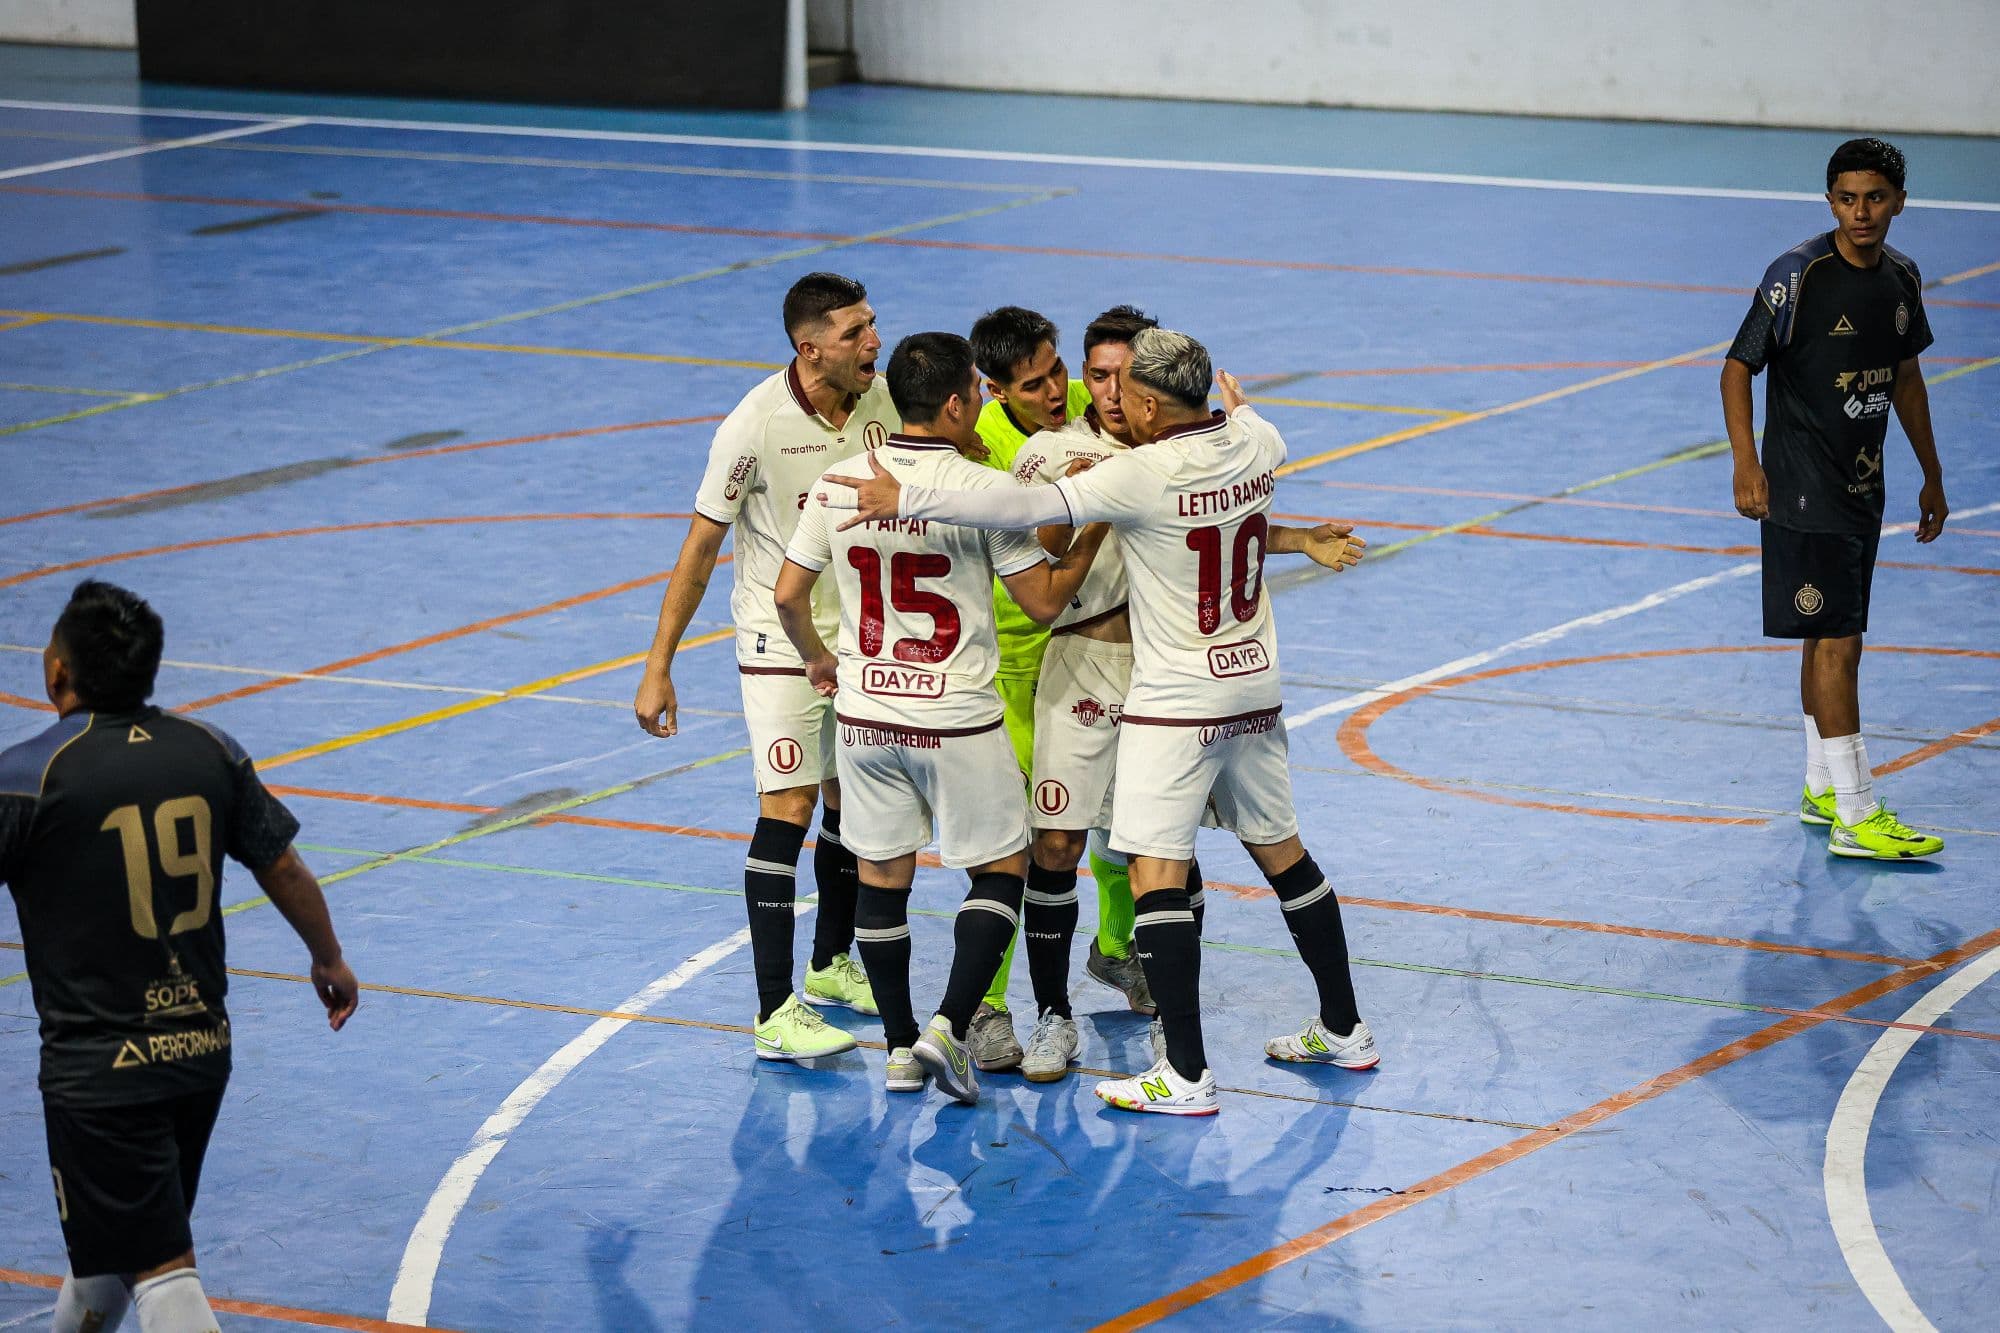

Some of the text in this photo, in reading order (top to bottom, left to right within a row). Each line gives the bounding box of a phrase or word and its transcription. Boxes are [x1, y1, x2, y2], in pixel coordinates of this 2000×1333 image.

[780, 444, 827, 455] marathon
[1065, 450, 1103, 461] marath
[1178, 469, 1275, 517] LETTO RAMOS
[1185, 512, 1269, 636] 10
[847, 545, 961, 664] 15
[1215, 647, 1263, 670] DAYR
[870, 669, 935, 691] DAYR
[100, 795, 215, 939] 19
